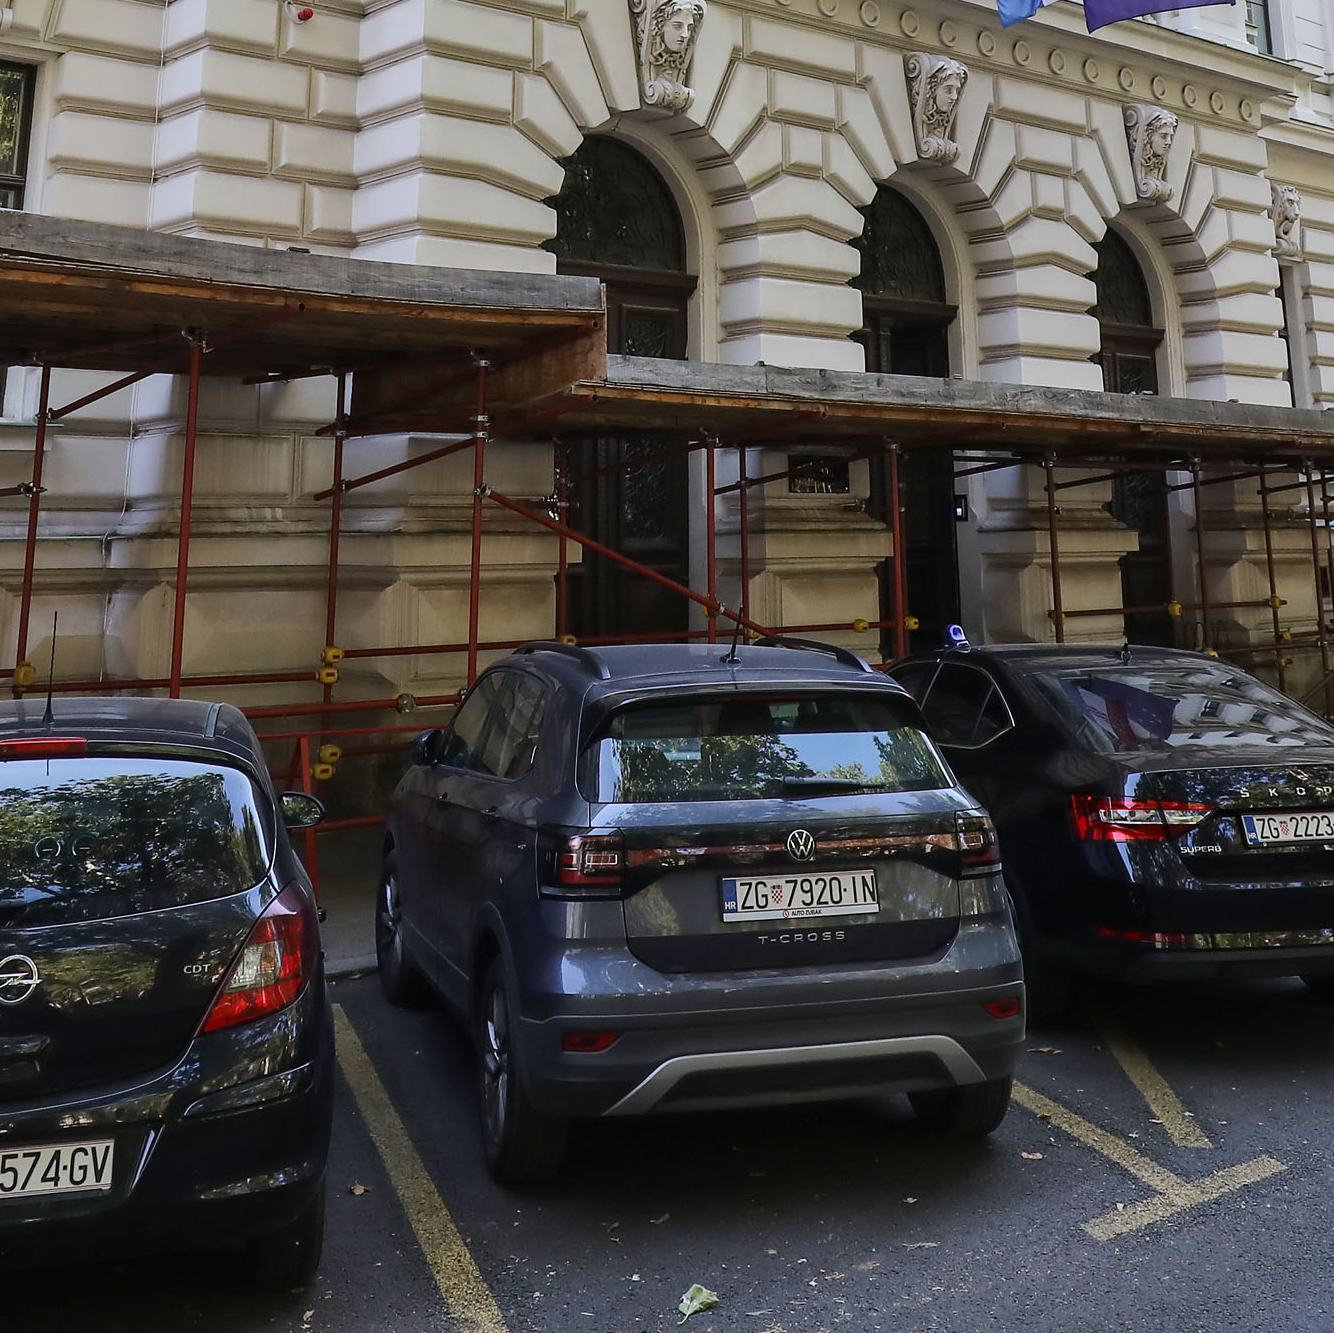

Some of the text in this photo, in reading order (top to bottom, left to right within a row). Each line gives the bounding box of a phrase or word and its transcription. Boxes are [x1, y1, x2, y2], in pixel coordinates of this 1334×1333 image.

[1256, 817, 1280, 839] ZG
[1180, 845, 1223, 854] SUPERB
[724, 901, 737, 910] HR
[739, 881, 768, 910] ZG
[758, 931, 845, 945] T-CROSS
